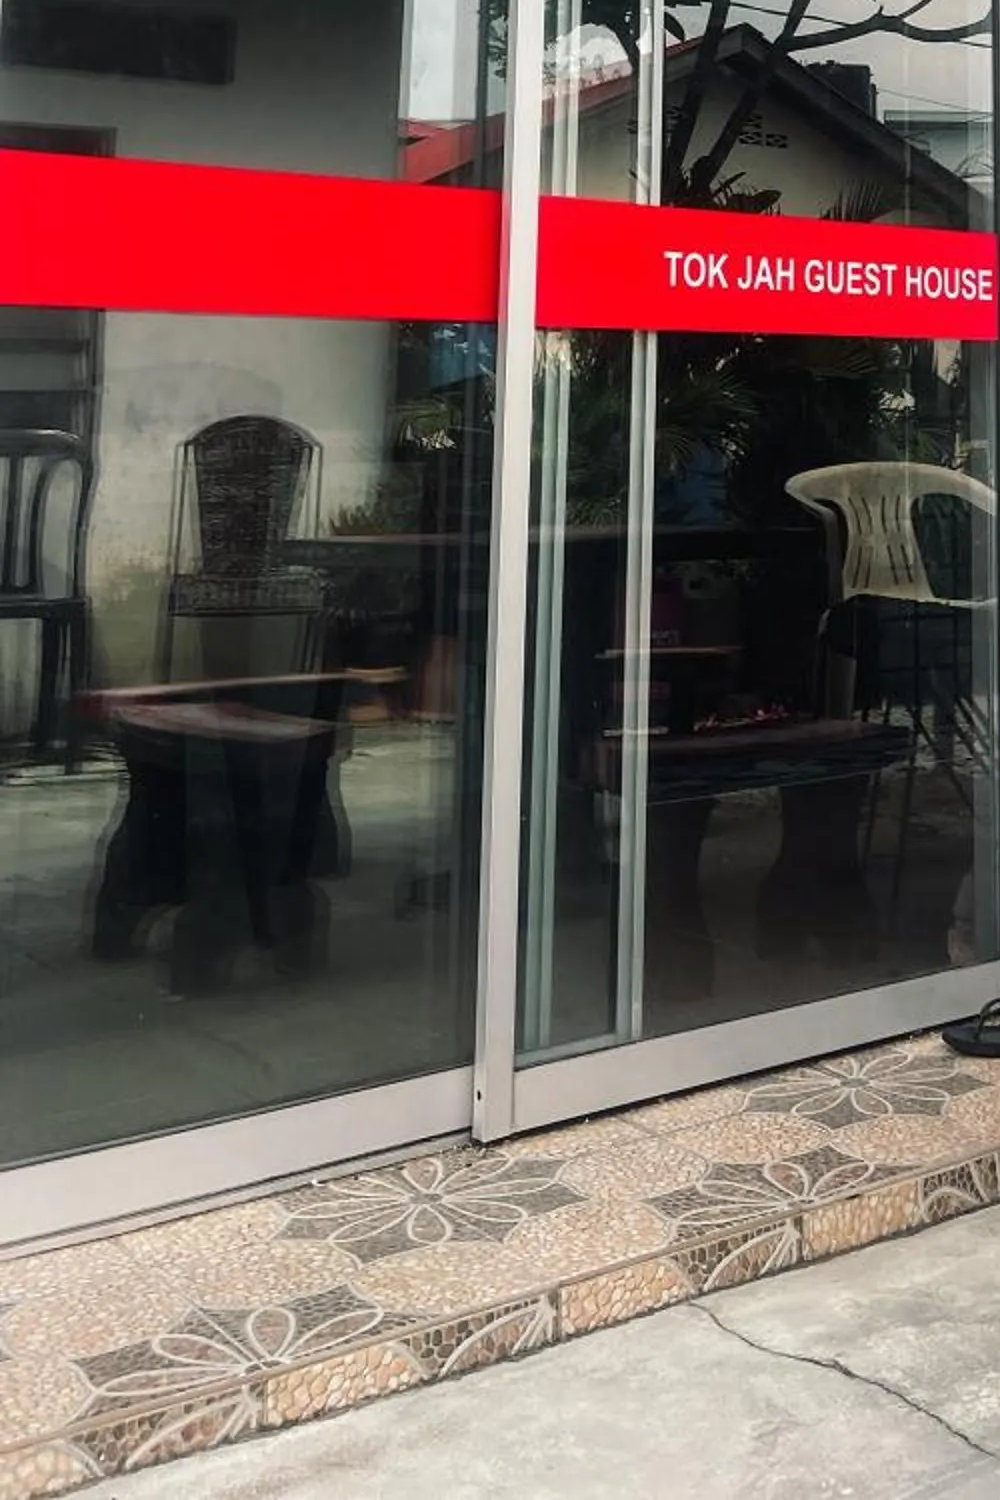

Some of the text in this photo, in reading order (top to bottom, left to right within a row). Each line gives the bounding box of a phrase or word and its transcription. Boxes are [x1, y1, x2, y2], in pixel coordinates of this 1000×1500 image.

[664, 251, 993, 301] TOK JAH GUEST HOUSE
